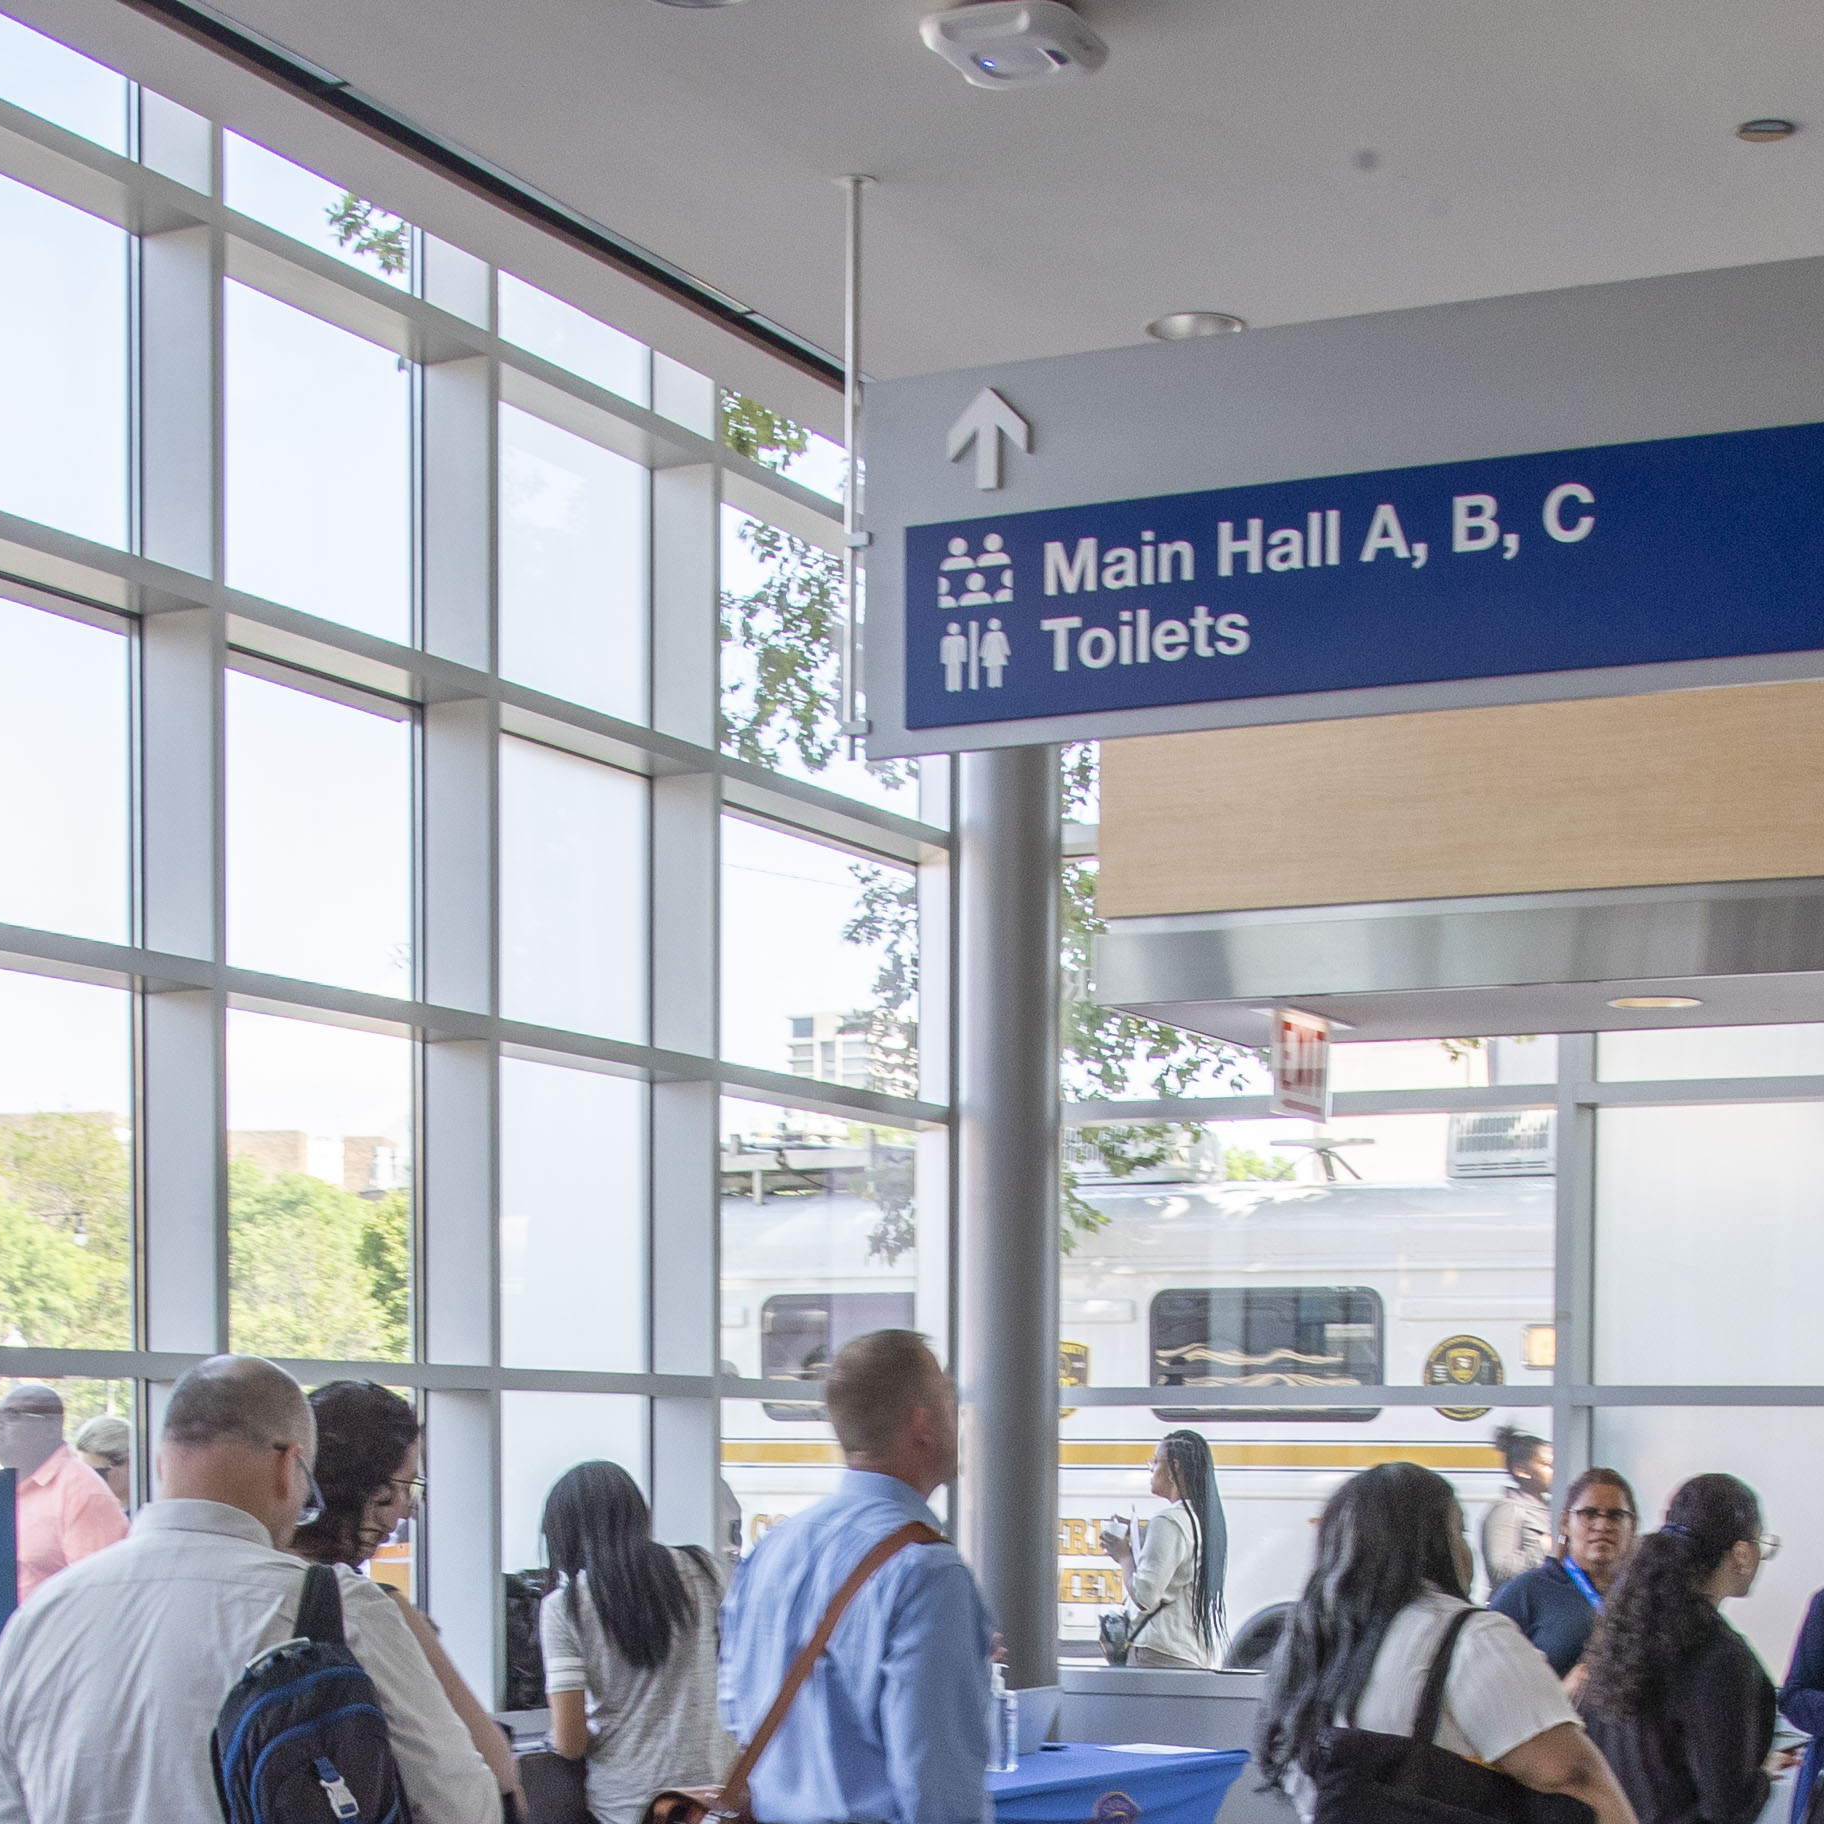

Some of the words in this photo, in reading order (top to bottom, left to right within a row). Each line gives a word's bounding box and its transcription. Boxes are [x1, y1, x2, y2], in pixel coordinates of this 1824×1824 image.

[1044, 530, 1194, 596] Main
[1218, 509, 1340, 577] Hall
[1361, 503, 1428, 569] A,
[1453, 493, 1519, 559] B,
[1543, 483, 1595, 543] C
[1040, 605, 1251, 672] Toilets
